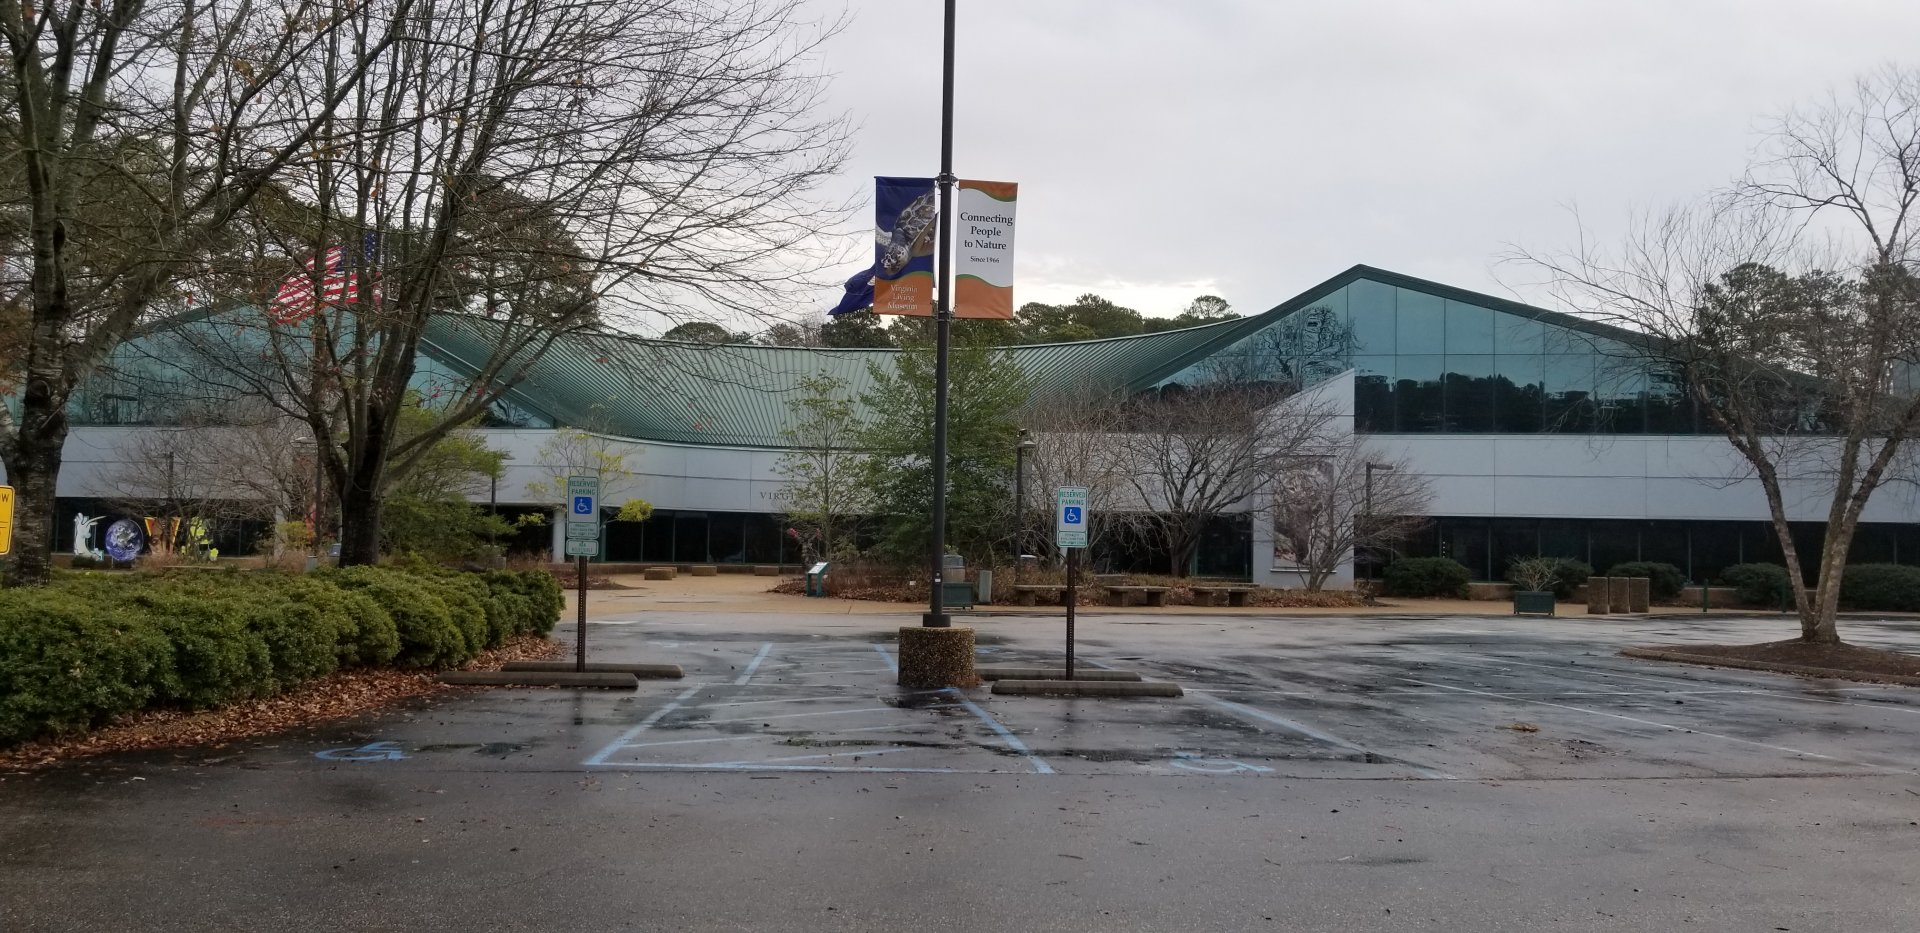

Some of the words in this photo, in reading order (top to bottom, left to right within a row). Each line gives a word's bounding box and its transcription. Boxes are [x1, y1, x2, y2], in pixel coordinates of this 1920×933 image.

[960, 212, 1013, 226] Connecting
[970, 226, 1002, 238] People
[964, 240, 973, 248] to
[975, 240, 1007, 250] Nature
[890, 284, 918, 294] Virginia
[893, 293, 915, 302] Living
[887, 302, 918, 310] Museum
